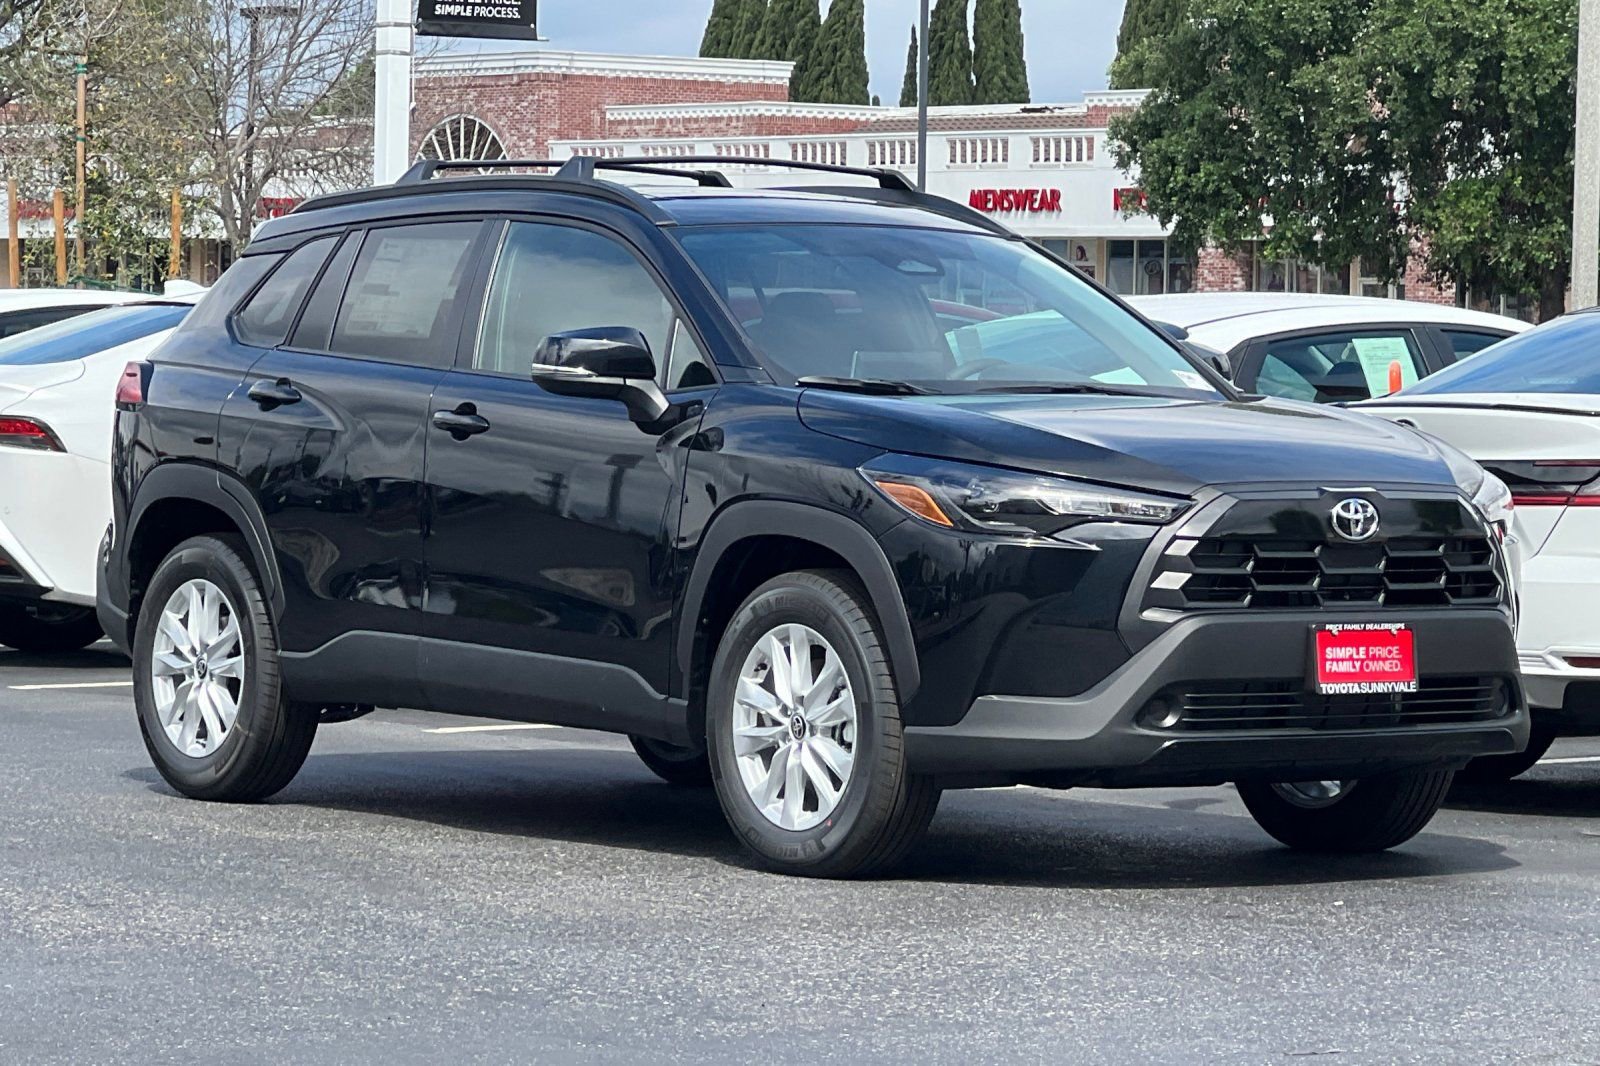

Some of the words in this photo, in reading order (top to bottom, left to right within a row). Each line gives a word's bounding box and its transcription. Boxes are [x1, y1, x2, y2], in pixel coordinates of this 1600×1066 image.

[434, 4, 473, 16] SIMPLE
[473, 6, 521, 18] PROCESS.
[969, 189, 1062, 212] MENSWEAR
[1325, 646, 1367, 659] SIMPLE
[1369, 646, 1402, 658] PRICE.
[1325, 660, 1361, 673] FAMILY
[1362, 659, 1404, 673] OWNED.
